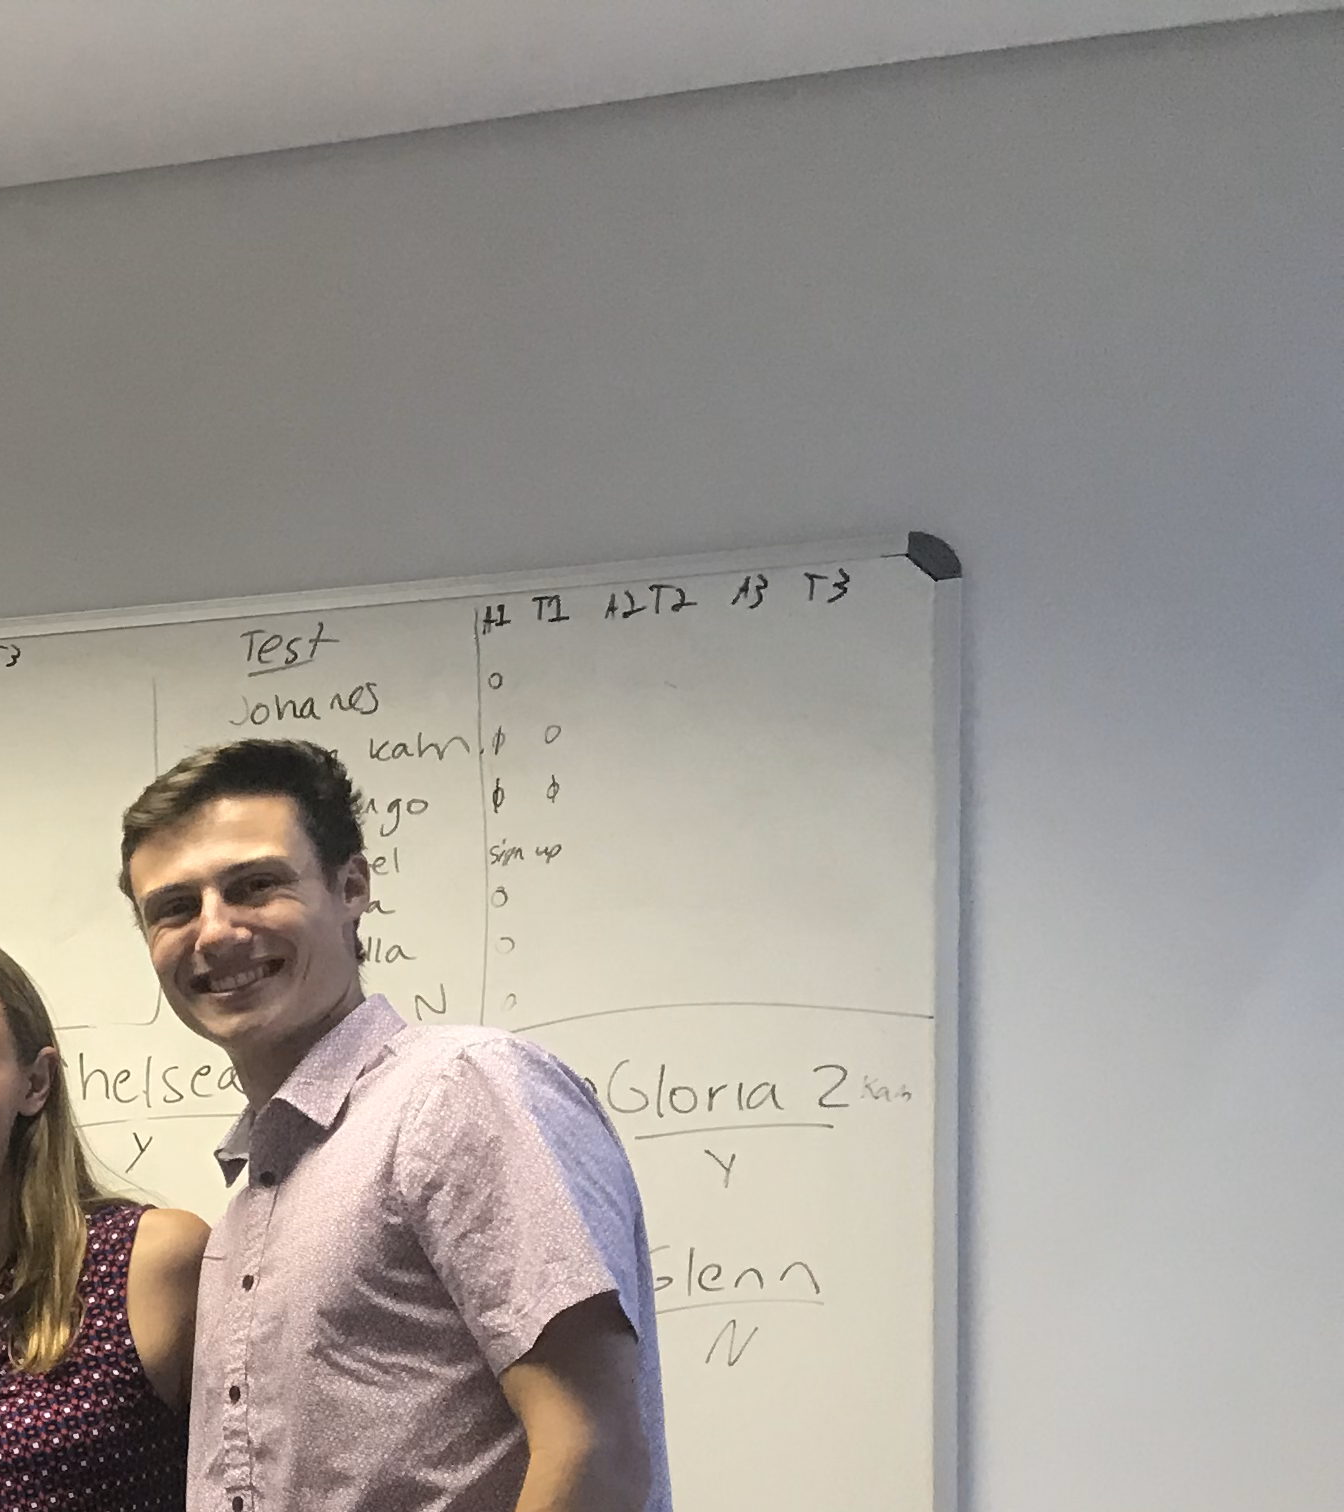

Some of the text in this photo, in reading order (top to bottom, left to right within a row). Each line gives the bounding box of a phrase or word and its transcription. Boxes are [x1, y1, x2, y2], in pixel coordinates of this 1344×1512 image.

[648, 583, 697, 614] T2
[803, 567, 851, 603] T3
[239, 621, 340, 666] Test
[61, 1052, 248, 1109] helsea
[606, 1059, 785, 1119] Gloria
[813, 1063, 851, 1108] 2
[704, 1148, 736, 1188] Y
[704, 1318, 759, 1367] N
